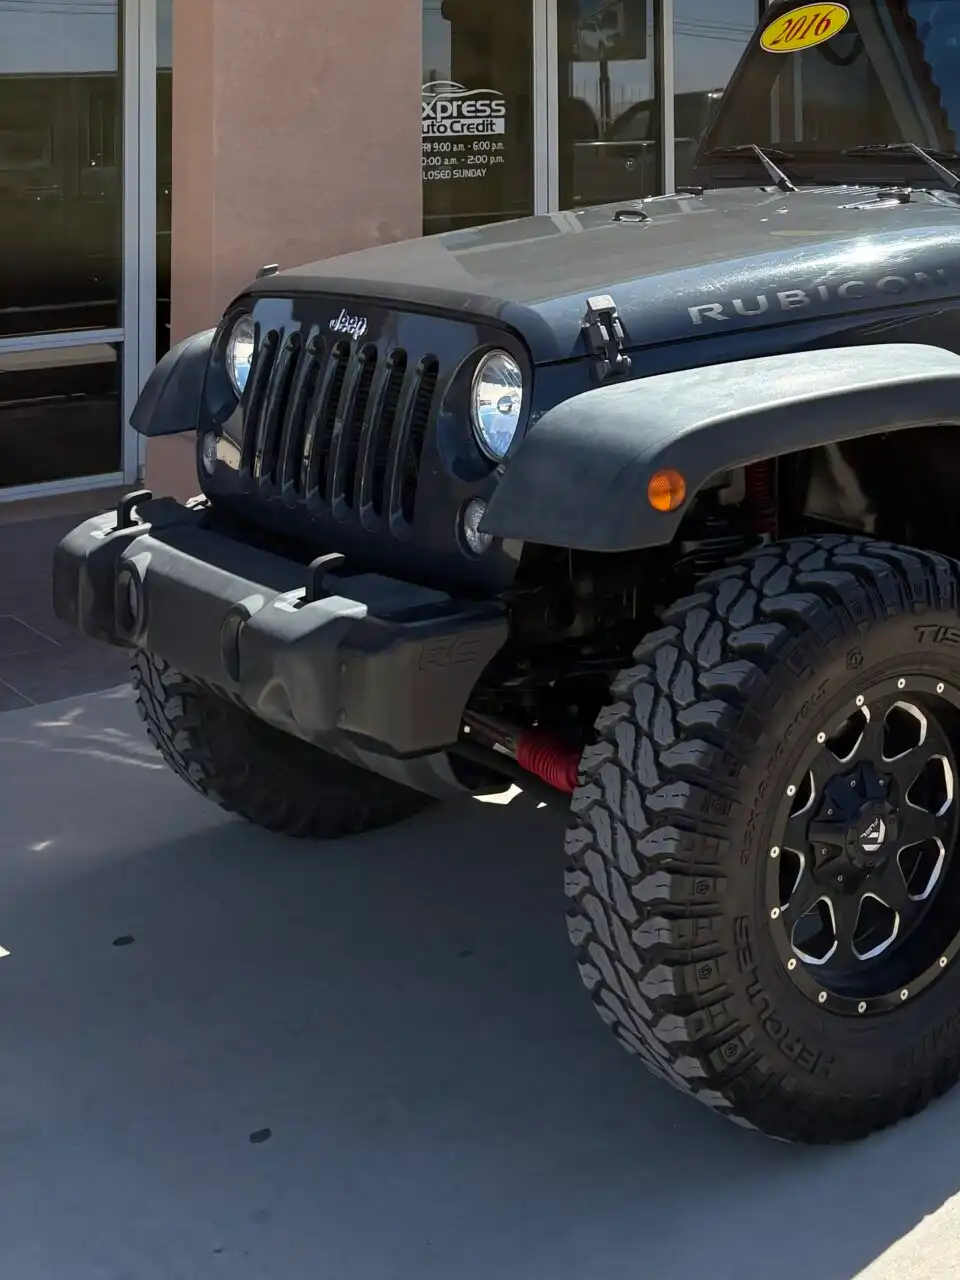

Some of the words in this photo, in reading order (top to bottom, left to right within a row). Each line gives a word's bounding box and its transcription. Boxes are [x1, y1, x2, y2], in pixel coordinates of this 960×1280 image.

[768, 7, 838, 46] 2016
[422, 100, 506, 123] xpress
[422, 120, 448, 135] uto
[450, 119, 497, 135] Credit
[472, 141, 490, 151] 6:00
[421, 156, 441, 166] 0:00
[467, 155, 488, 164] 2:00
[490, 156, 505, 165] p.m.
[422, 169, 451, 180] LOSED
[453, 168, 487, 179] SUNDAY
[687, 269, 949, 326] RUBICON
